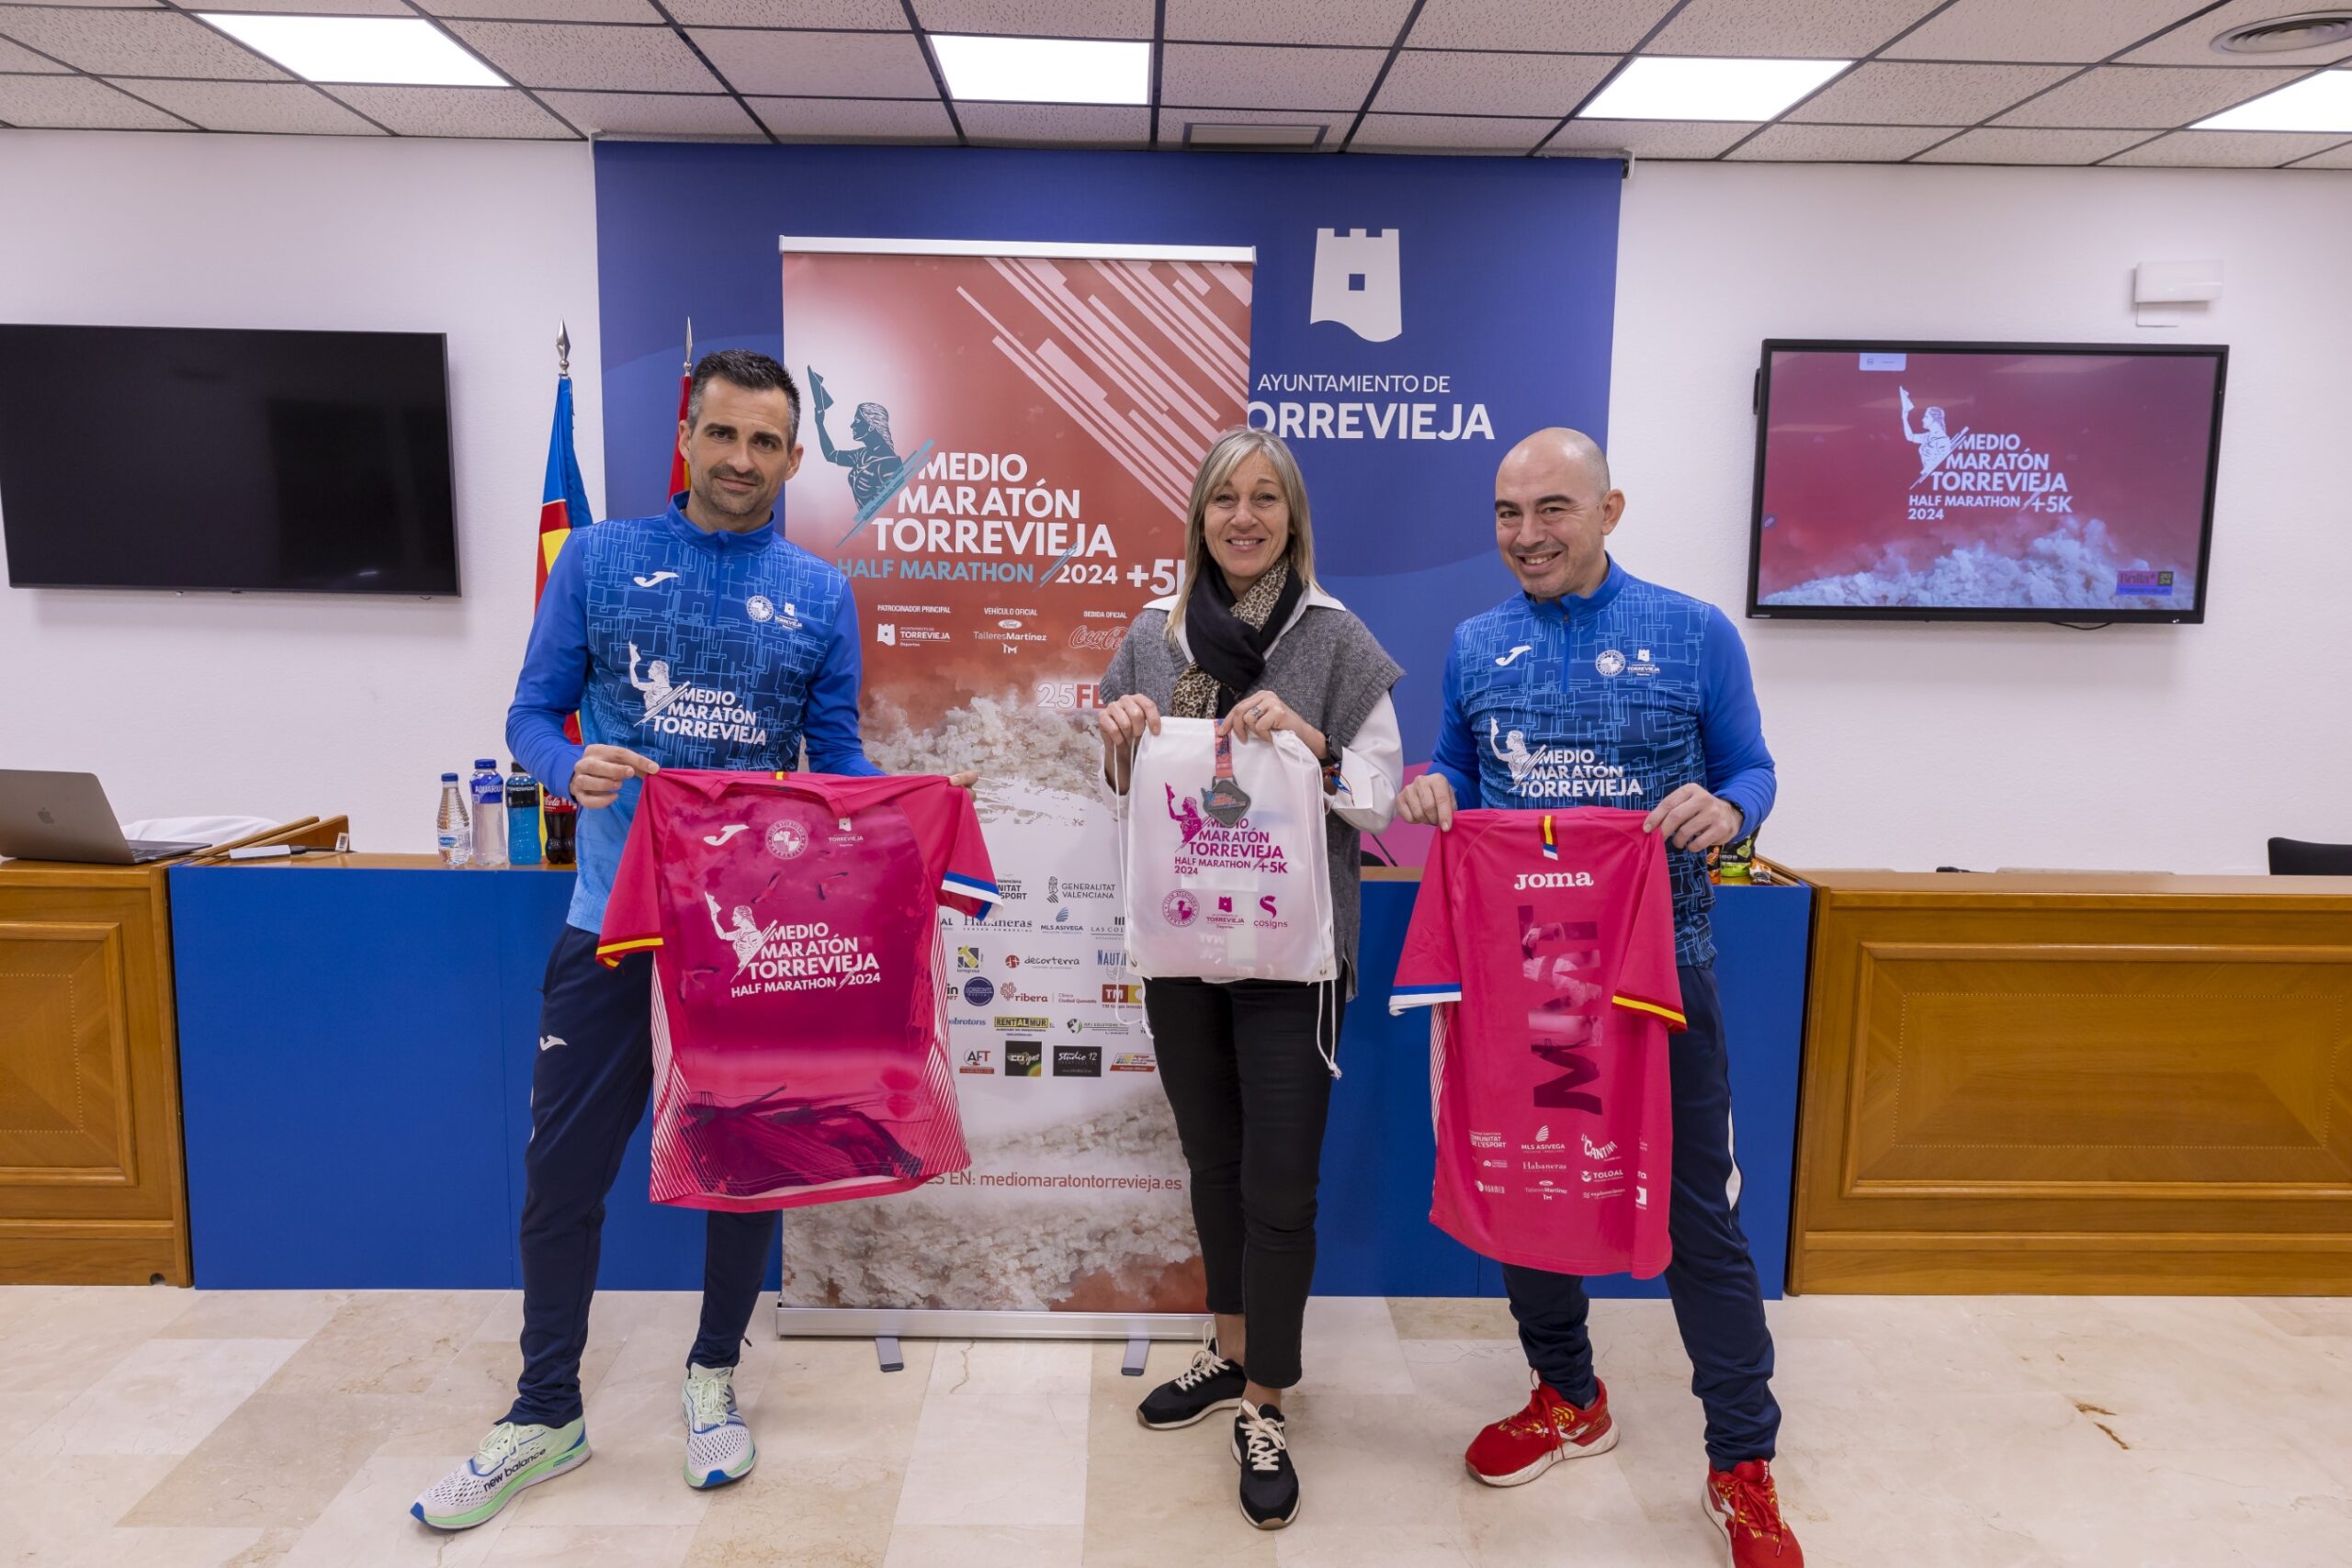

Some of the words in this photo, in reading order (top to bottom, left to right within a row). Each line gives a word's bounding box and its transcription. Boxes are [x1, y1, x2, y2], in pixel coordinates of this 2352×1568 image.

[1257, 373, 1419, 393] AYUNTAMIENTO
[1422, 375, 1452, 393] DE
[1247, 400, 1496, 442] ORREVIEJA
[1958, 434, 2021, 451] MEDIO
[918, 451, 1028, 483] MEDIO
[1945, 447, 2050, 470] MARATÓN
[1931, 470, 2069, 492] TORREVIEJA
[897, 478, 1080, 519] MARATÓN
[1908, 494, 1942, 506] HALF
[1944, 495, 2021, 508] MARATHON
[2031, 496, 2074, 513] +5K
[1907, 508, 1945, 520] 2024
[871, 517, 1118, 558] TORREVIEJA
[837, 558, 894, 579] HALF
[899, 559, 1035, 583] MARATHON
[1055, 564, 1119, 585] 2024
[877, 604, 921, 613] PATROCINADOR
[922, 605, 951, 614] PRINCIPAL
[984, 606, 1014, 615] VEHÍCULO
[1015, 608, 1038, 616] OFICIAL
[899, 630, 951, 640] TORREVIEJA
[1069, 625, 1128, 650] Coca-Co
[678, 687, 736, 706] MEDIO
[667, 702, 757, 727] MARATÓN
[653, 716, 766, 746] TORREVIEJA
[1538, 749, 1596, 764] MEDIO
[1531, 761, 1624, 780] MARATÓN
[1521, 779, 1645, 798] TORREVIEJA
[1206, 817, 1250, 829] MIO
[828, 835, 864, 843] TORREVIEJA
[1198, 828, 1270, 843] MARATÓN
[1189, 841, 1284, 859] TORREVIEJA
[1174, 856, 1197, 865] HALF
[1198, 859, 1251, 869] MARATHON
[1259, 862, 1289, 874] +5K
[1174, 865, 1199, 875] 2024
[998, 884, 1022, 892] NITAT
[1061, 883, 1116, 891] GENERALITAT
[1062, 891, 1114, 899] VALENCIANA
[1000, 892, 1028, 900] SPORT
[1205, 916, 1245, 924] TORREVIEJA
[1253, 919, 1288, 930] cosigns
[770, 921, 830, 942] MEDIO
[760, 933, 859, 960] MARATÓN
[747, 952, 880, 980] TORREVIEJA
[1023, 955, 1080, 965] decorterra
[730, 982, 763, 998] HALF
[763, 976, 837, 993] MARATHON
[847, 972, 882, 986] 2024
[1014, 992, 1049, 1003] ribera
[948, 1017, 987, 1026] obrotons
[967, 1050, 991, 1062] AFT
[1057, 1051, 1086, 1062] Studio
[1089, 1052, 1098, 1061] 12
[1522, 1161, 1567, 1170] Habaneras
[1593, 1168, 1624, 1179] TOLOAL
[950, 1170, 976, 1185] EN:
[980, 1172, 1182, 1192] mediomaratontorrevieja.es
[482, 1473, 503, 1493] new
[504, 1448, 547, 1478] balance
